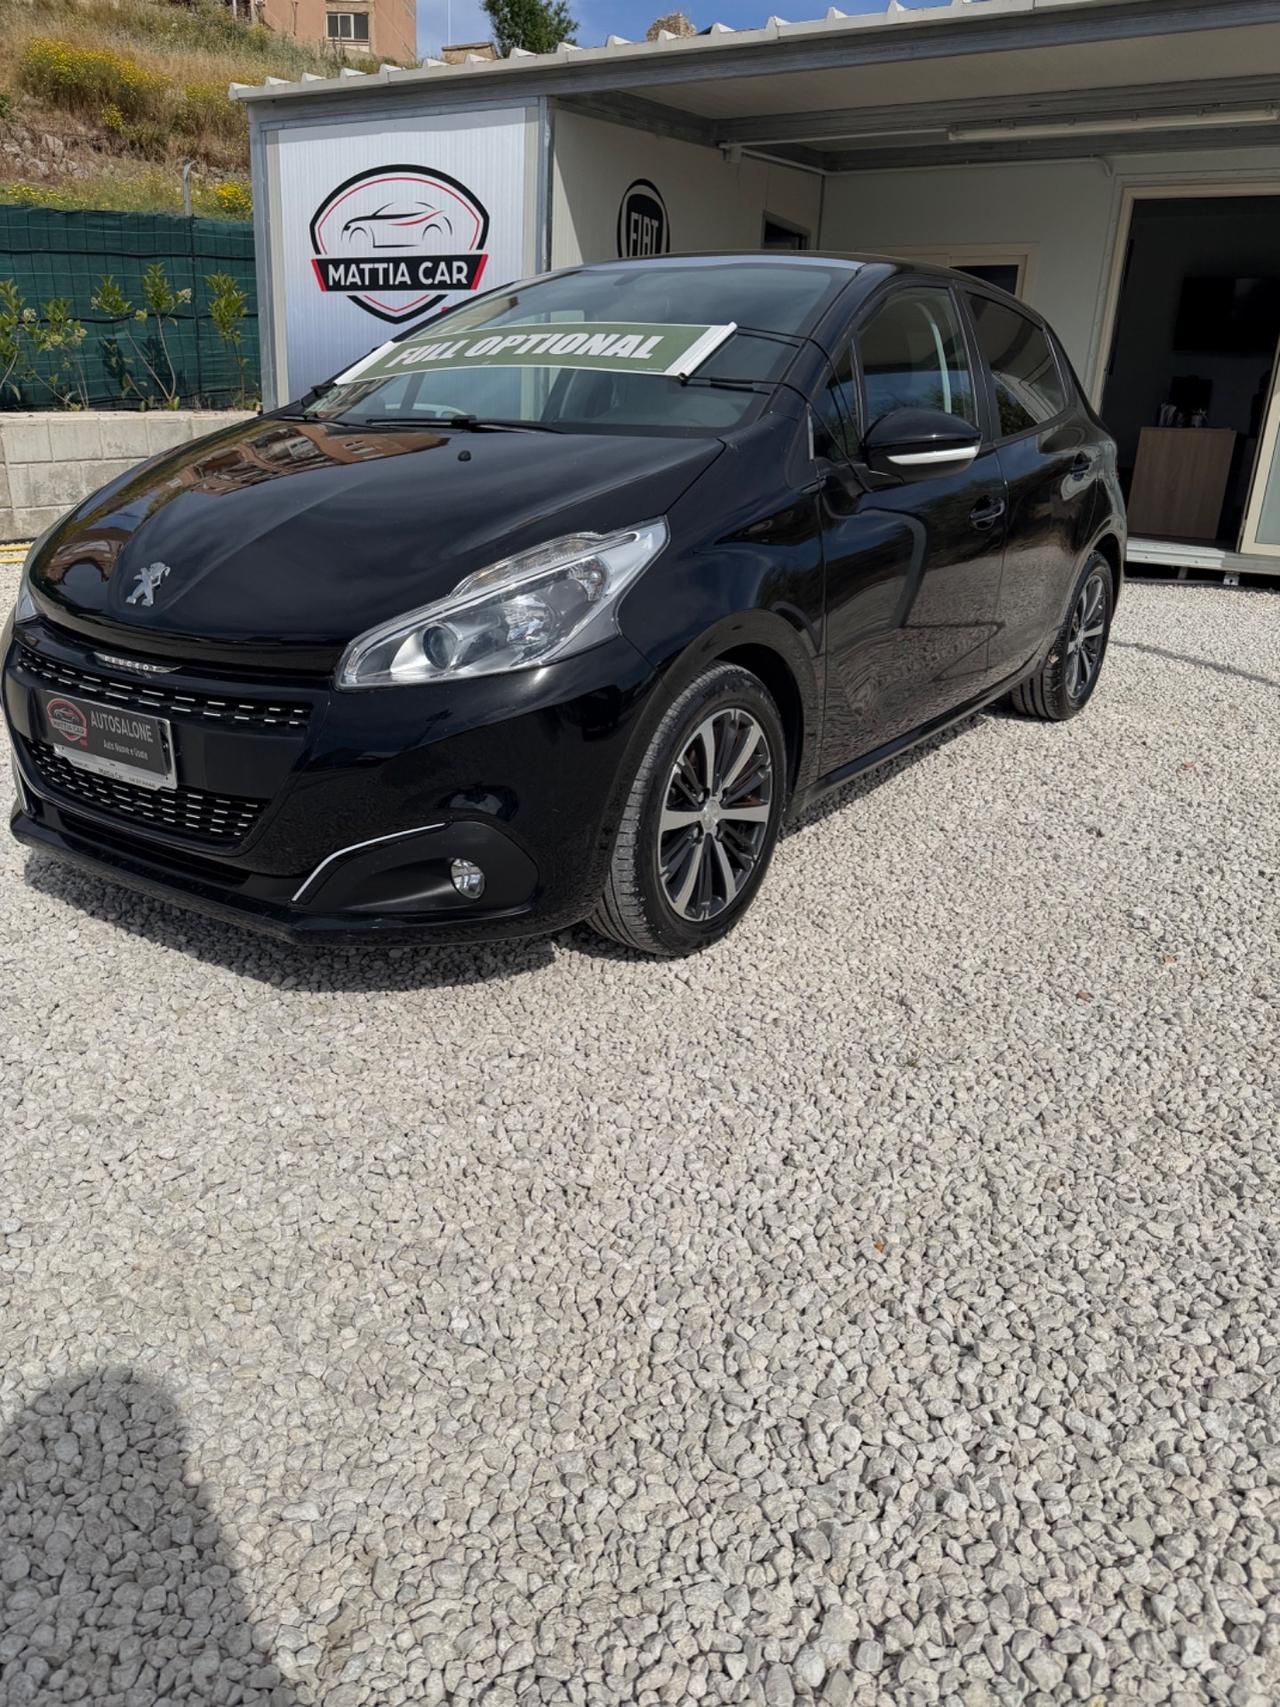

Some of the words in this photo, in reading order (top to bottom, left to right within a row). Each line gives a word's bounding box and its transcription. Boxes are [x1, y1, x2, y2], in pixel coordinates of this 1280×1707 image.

[629, 211, 660, 257] FIAT
[328, 261, 411, 287] MATTIA
[418, 260, 469, 286] CAR
[384, 338, 470, 368] FULL
[464, 333, 664, 360] OPTIONAL
[104, 655, 157, 672] PEUGEOT
[90, 710, 154, 743] AUTOSALONE
